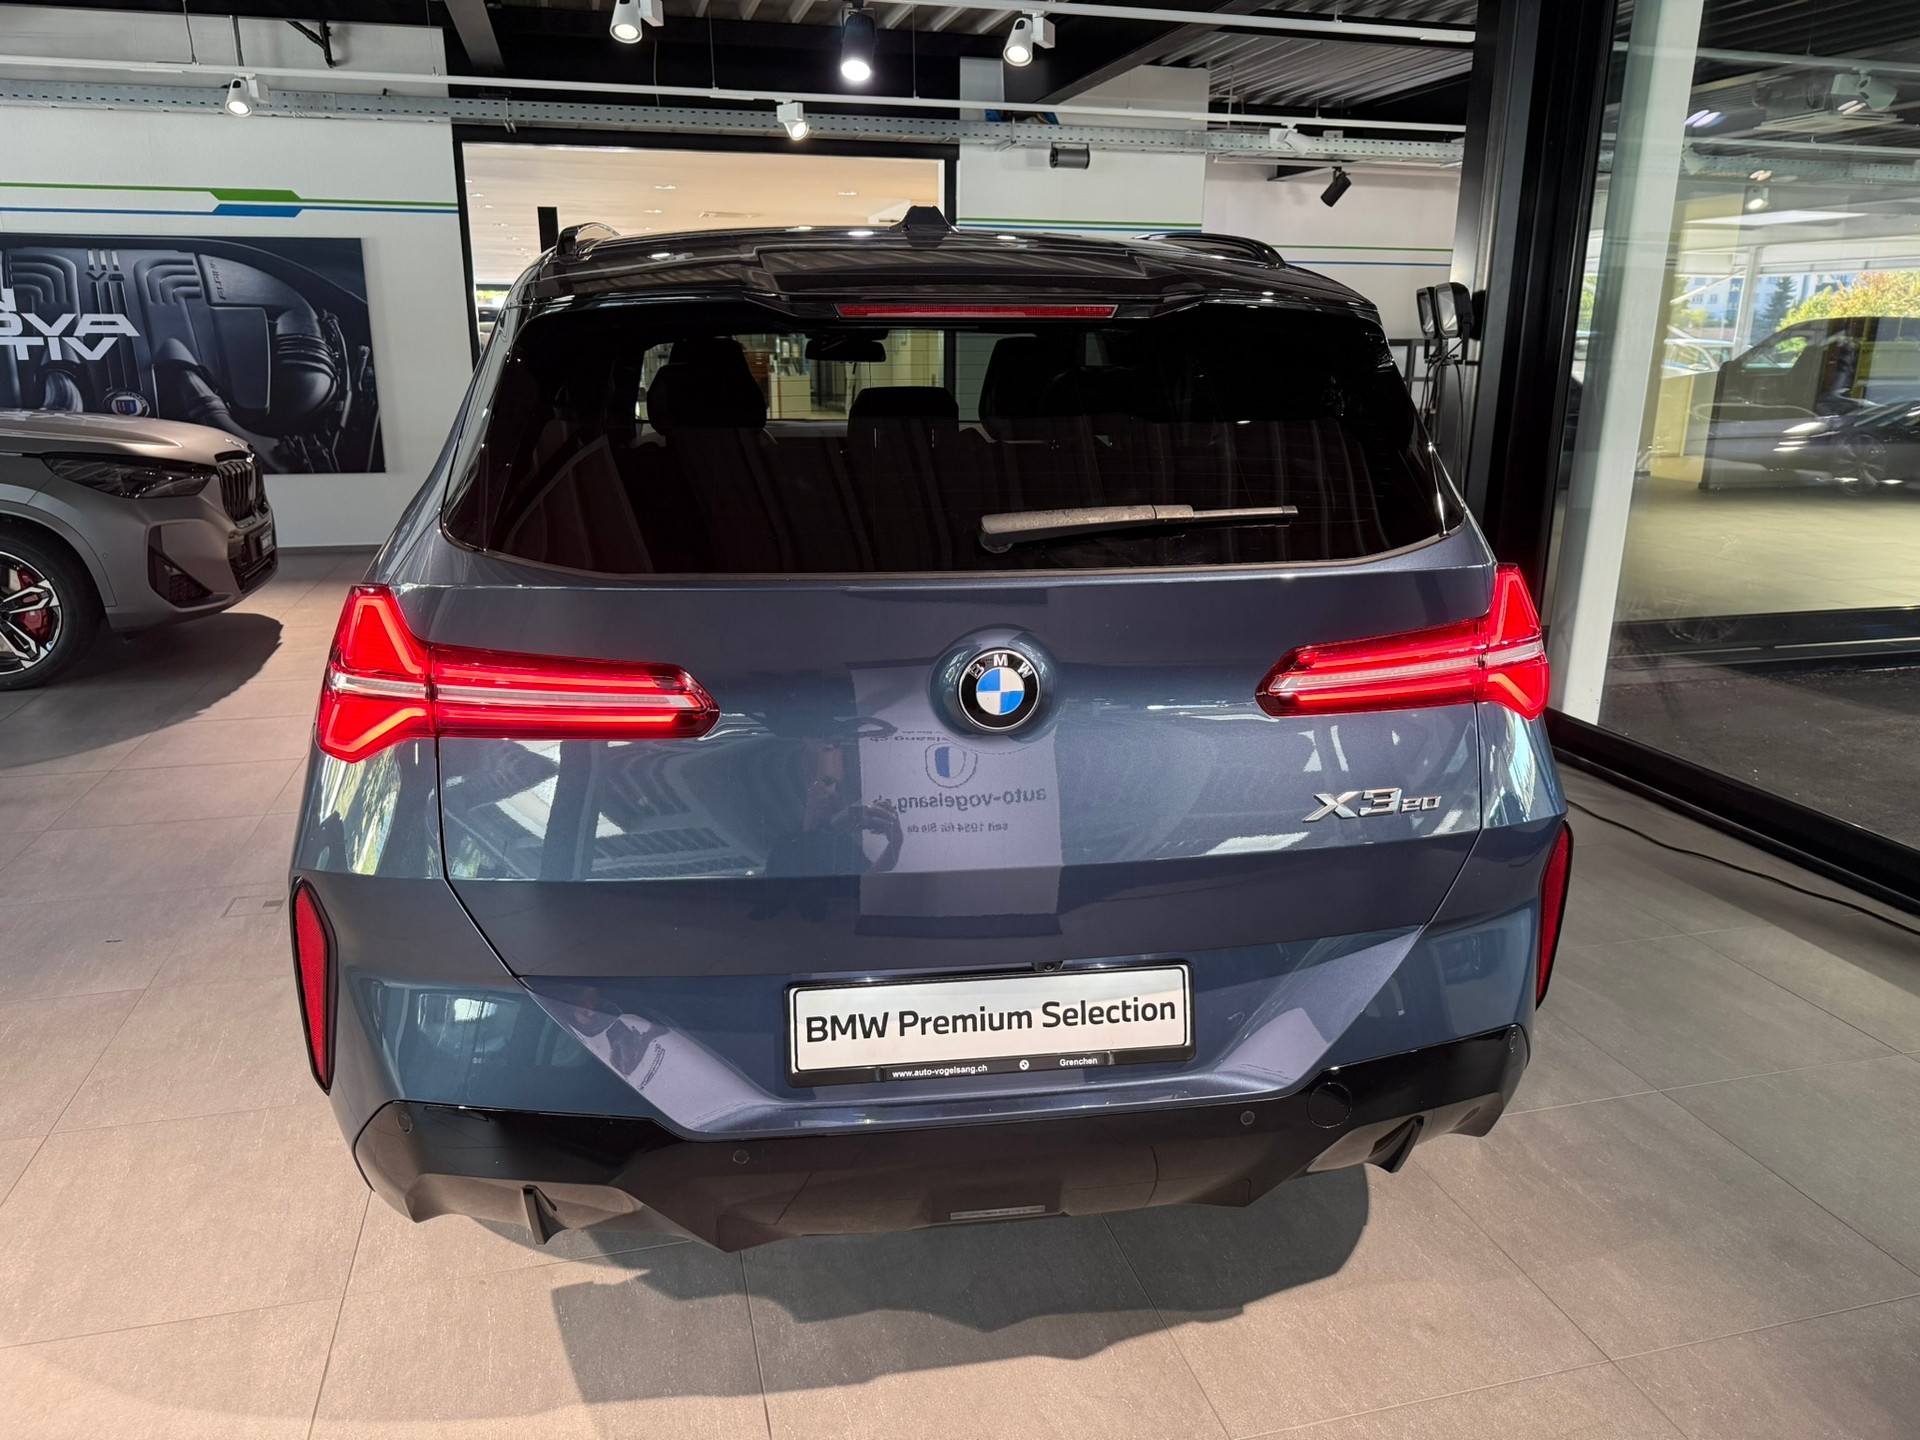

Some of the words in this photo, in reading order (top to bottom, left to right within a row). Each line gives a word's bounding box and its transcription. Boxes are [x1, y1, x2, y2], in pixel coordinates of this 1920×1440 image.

[968, 653, 1033, 679] BMW
[806, 1011, 889, 1043] BMW
[899, 1005, 1033, 1037] Premium
[1042, 996, 1176, 1028] Selection
[892, 1064, 988, 1078] www.auto-vogelsang.ch
[1059, 1057, 1098, 1067] Grenchen
